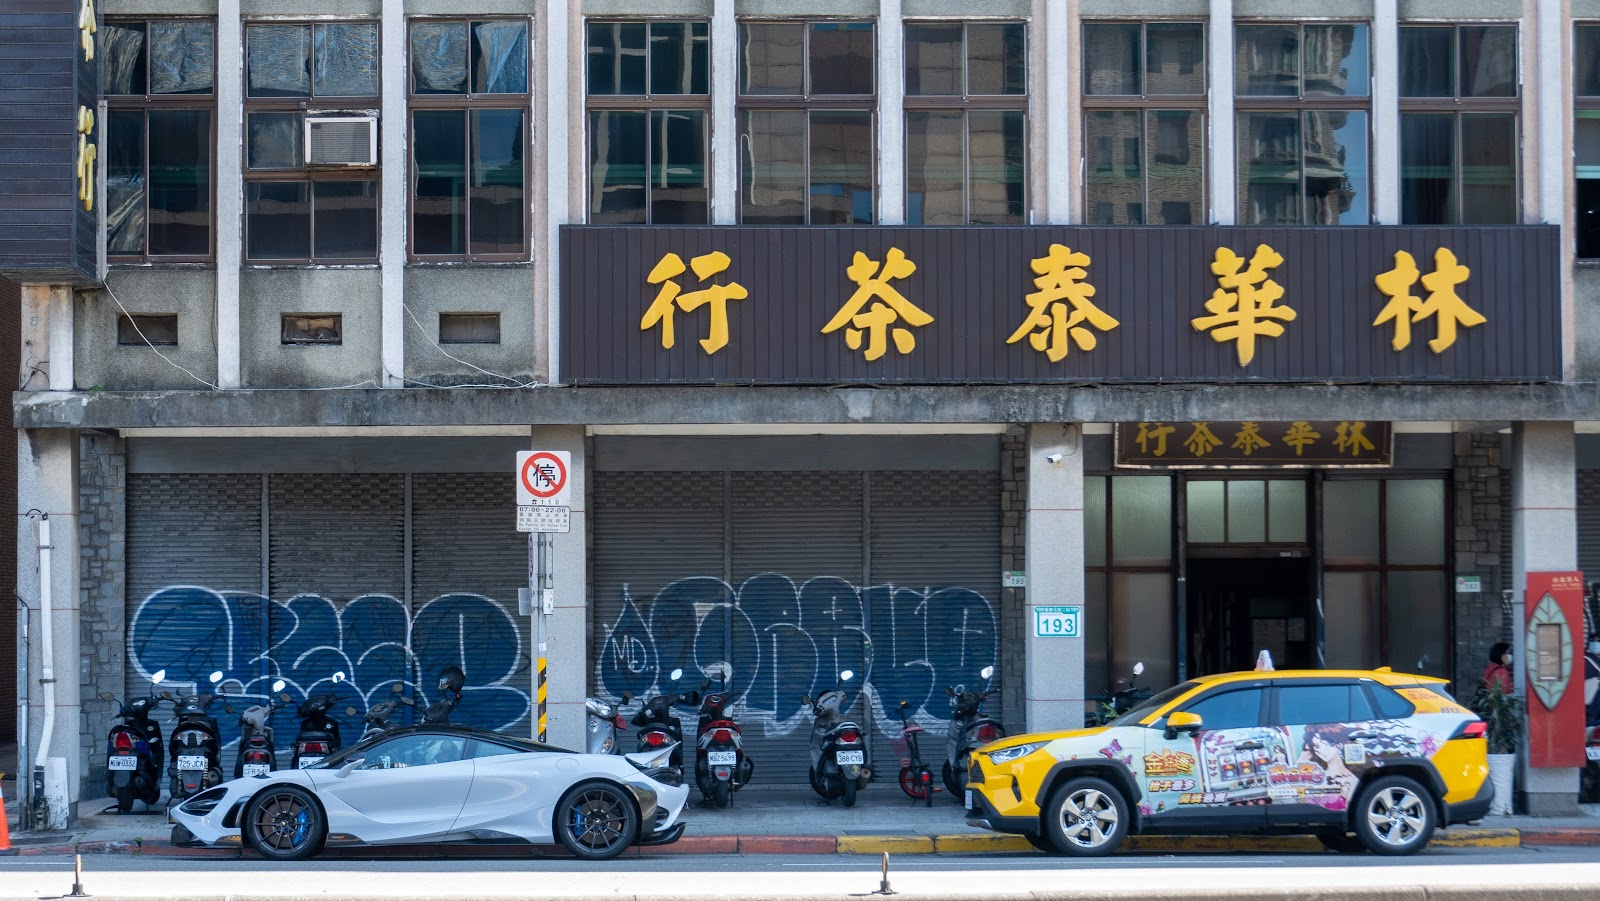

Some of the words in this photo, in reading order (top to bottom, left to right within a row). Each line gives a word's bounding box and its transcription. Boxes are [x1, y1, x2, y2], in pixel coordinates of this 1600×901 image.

[533, 464, 556, 487] 停
[1011, 577, 1025, 585] 195
[1042, 618, 1074, 633] 193
